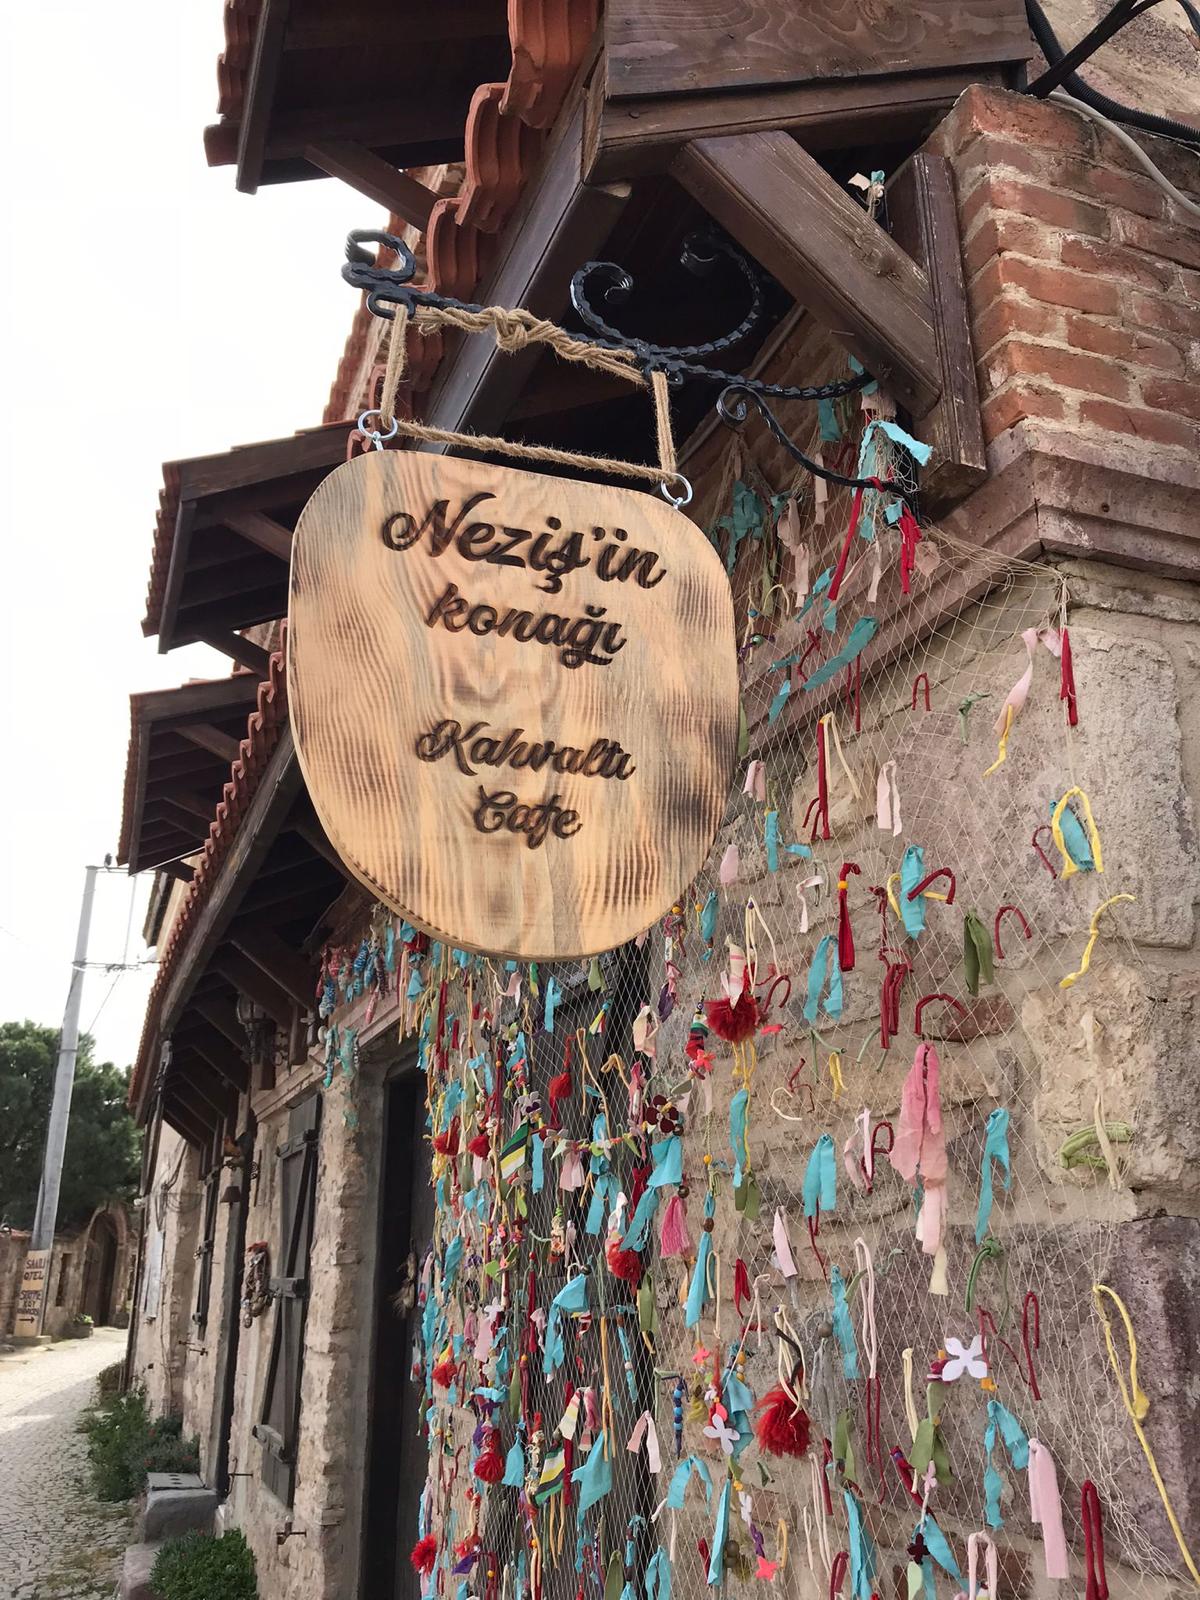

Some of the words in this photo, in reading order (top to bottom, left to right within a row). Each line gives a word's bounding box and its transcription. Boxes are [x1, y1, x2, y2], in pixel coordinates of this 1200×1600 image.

[382, 493, 666, 593] Neziş'in
[424, 583, 627, 669] konağı
[416, 719, 636, 781] Kahvaltı
[473, 785, 583, 850] Cafe
